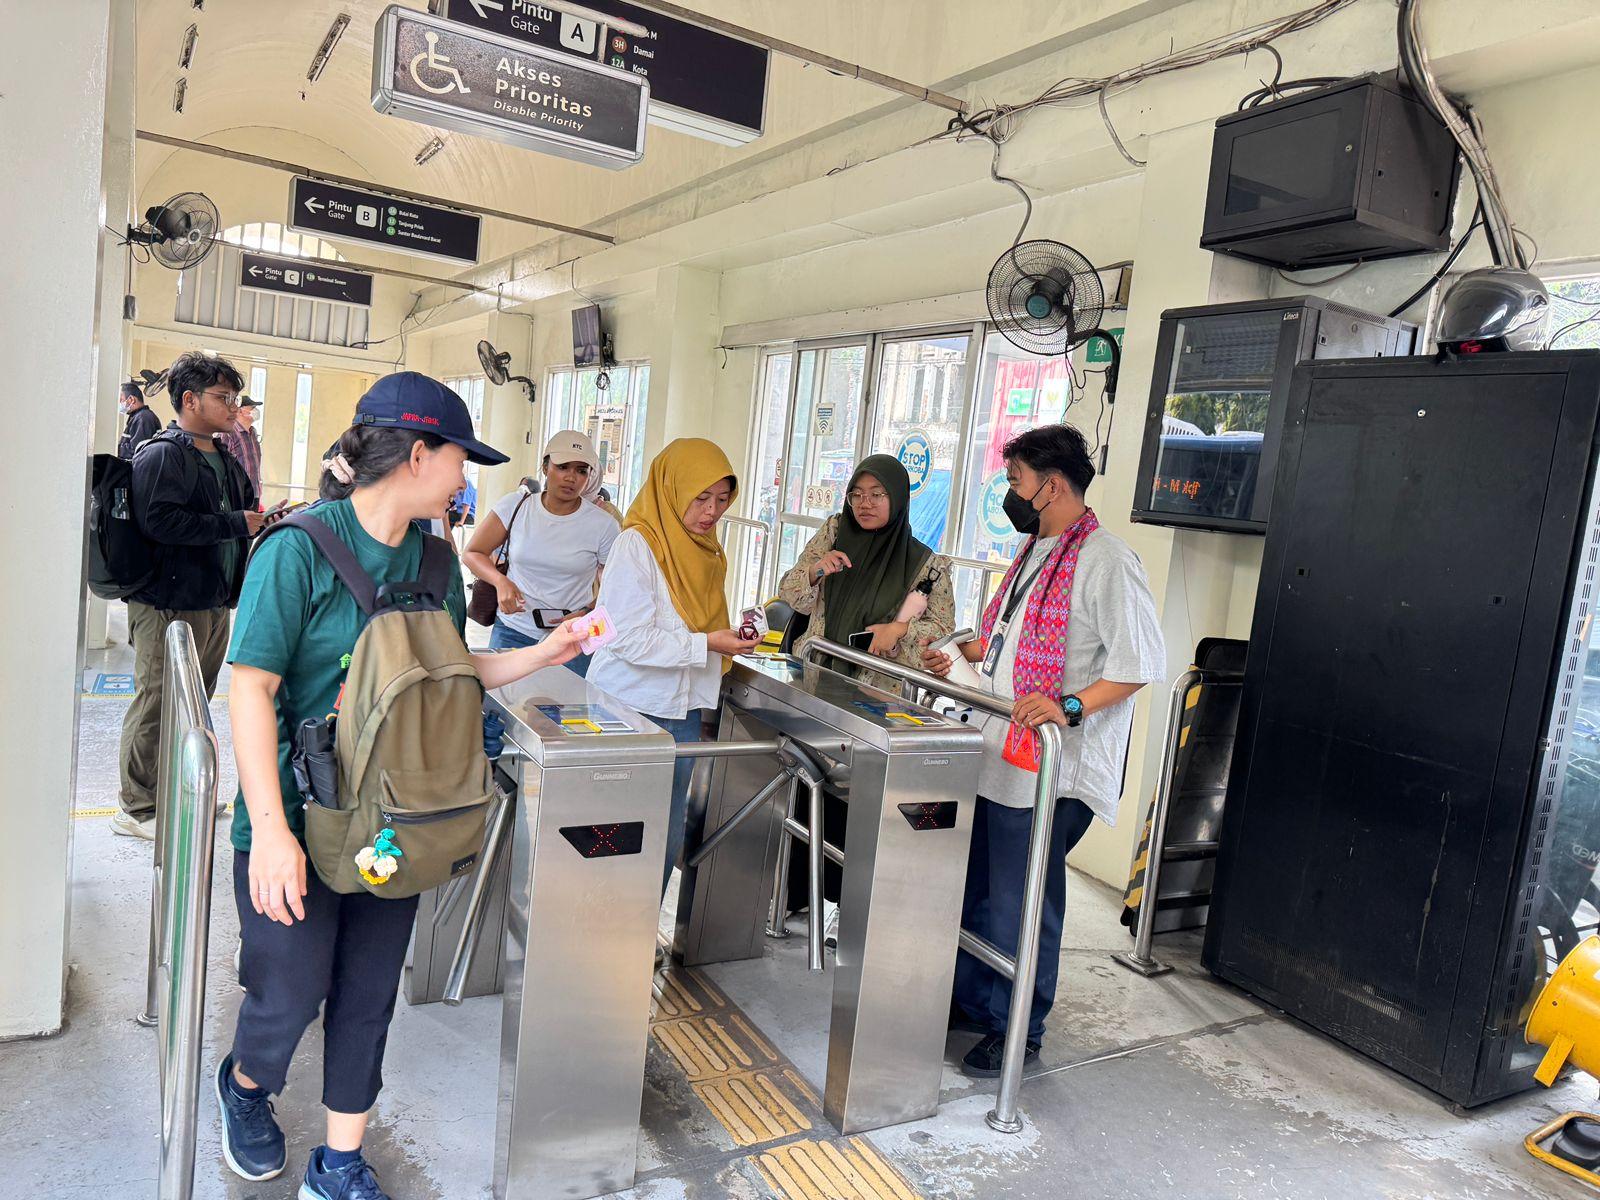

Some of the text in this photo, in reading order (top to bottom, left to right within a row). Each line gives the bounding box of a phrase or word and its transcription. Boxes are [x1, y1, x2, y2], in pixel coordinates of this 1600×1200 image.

[511, 0, 553, 22] Pintu
[510, 15, 540, 35] Gate
[570, 22, 584, 42] A
[614, 39, 654, 59] 3H Damai
[496, 56, 562, 88] Akses
[611, 57, 648, 76] 12A Kota
[495, 78, 592, 118] Prioritas
[493, 100, 584, 132] Disable Priority
[328, 200, 353, 213] Pintu
[328, 210, 346, 220] Gate
[362, 211, 370, 221] B
[265, 267, 282, 276] Pintu
[289, 273, 295, 281] C
[902, 452, 925, 466] STOP
